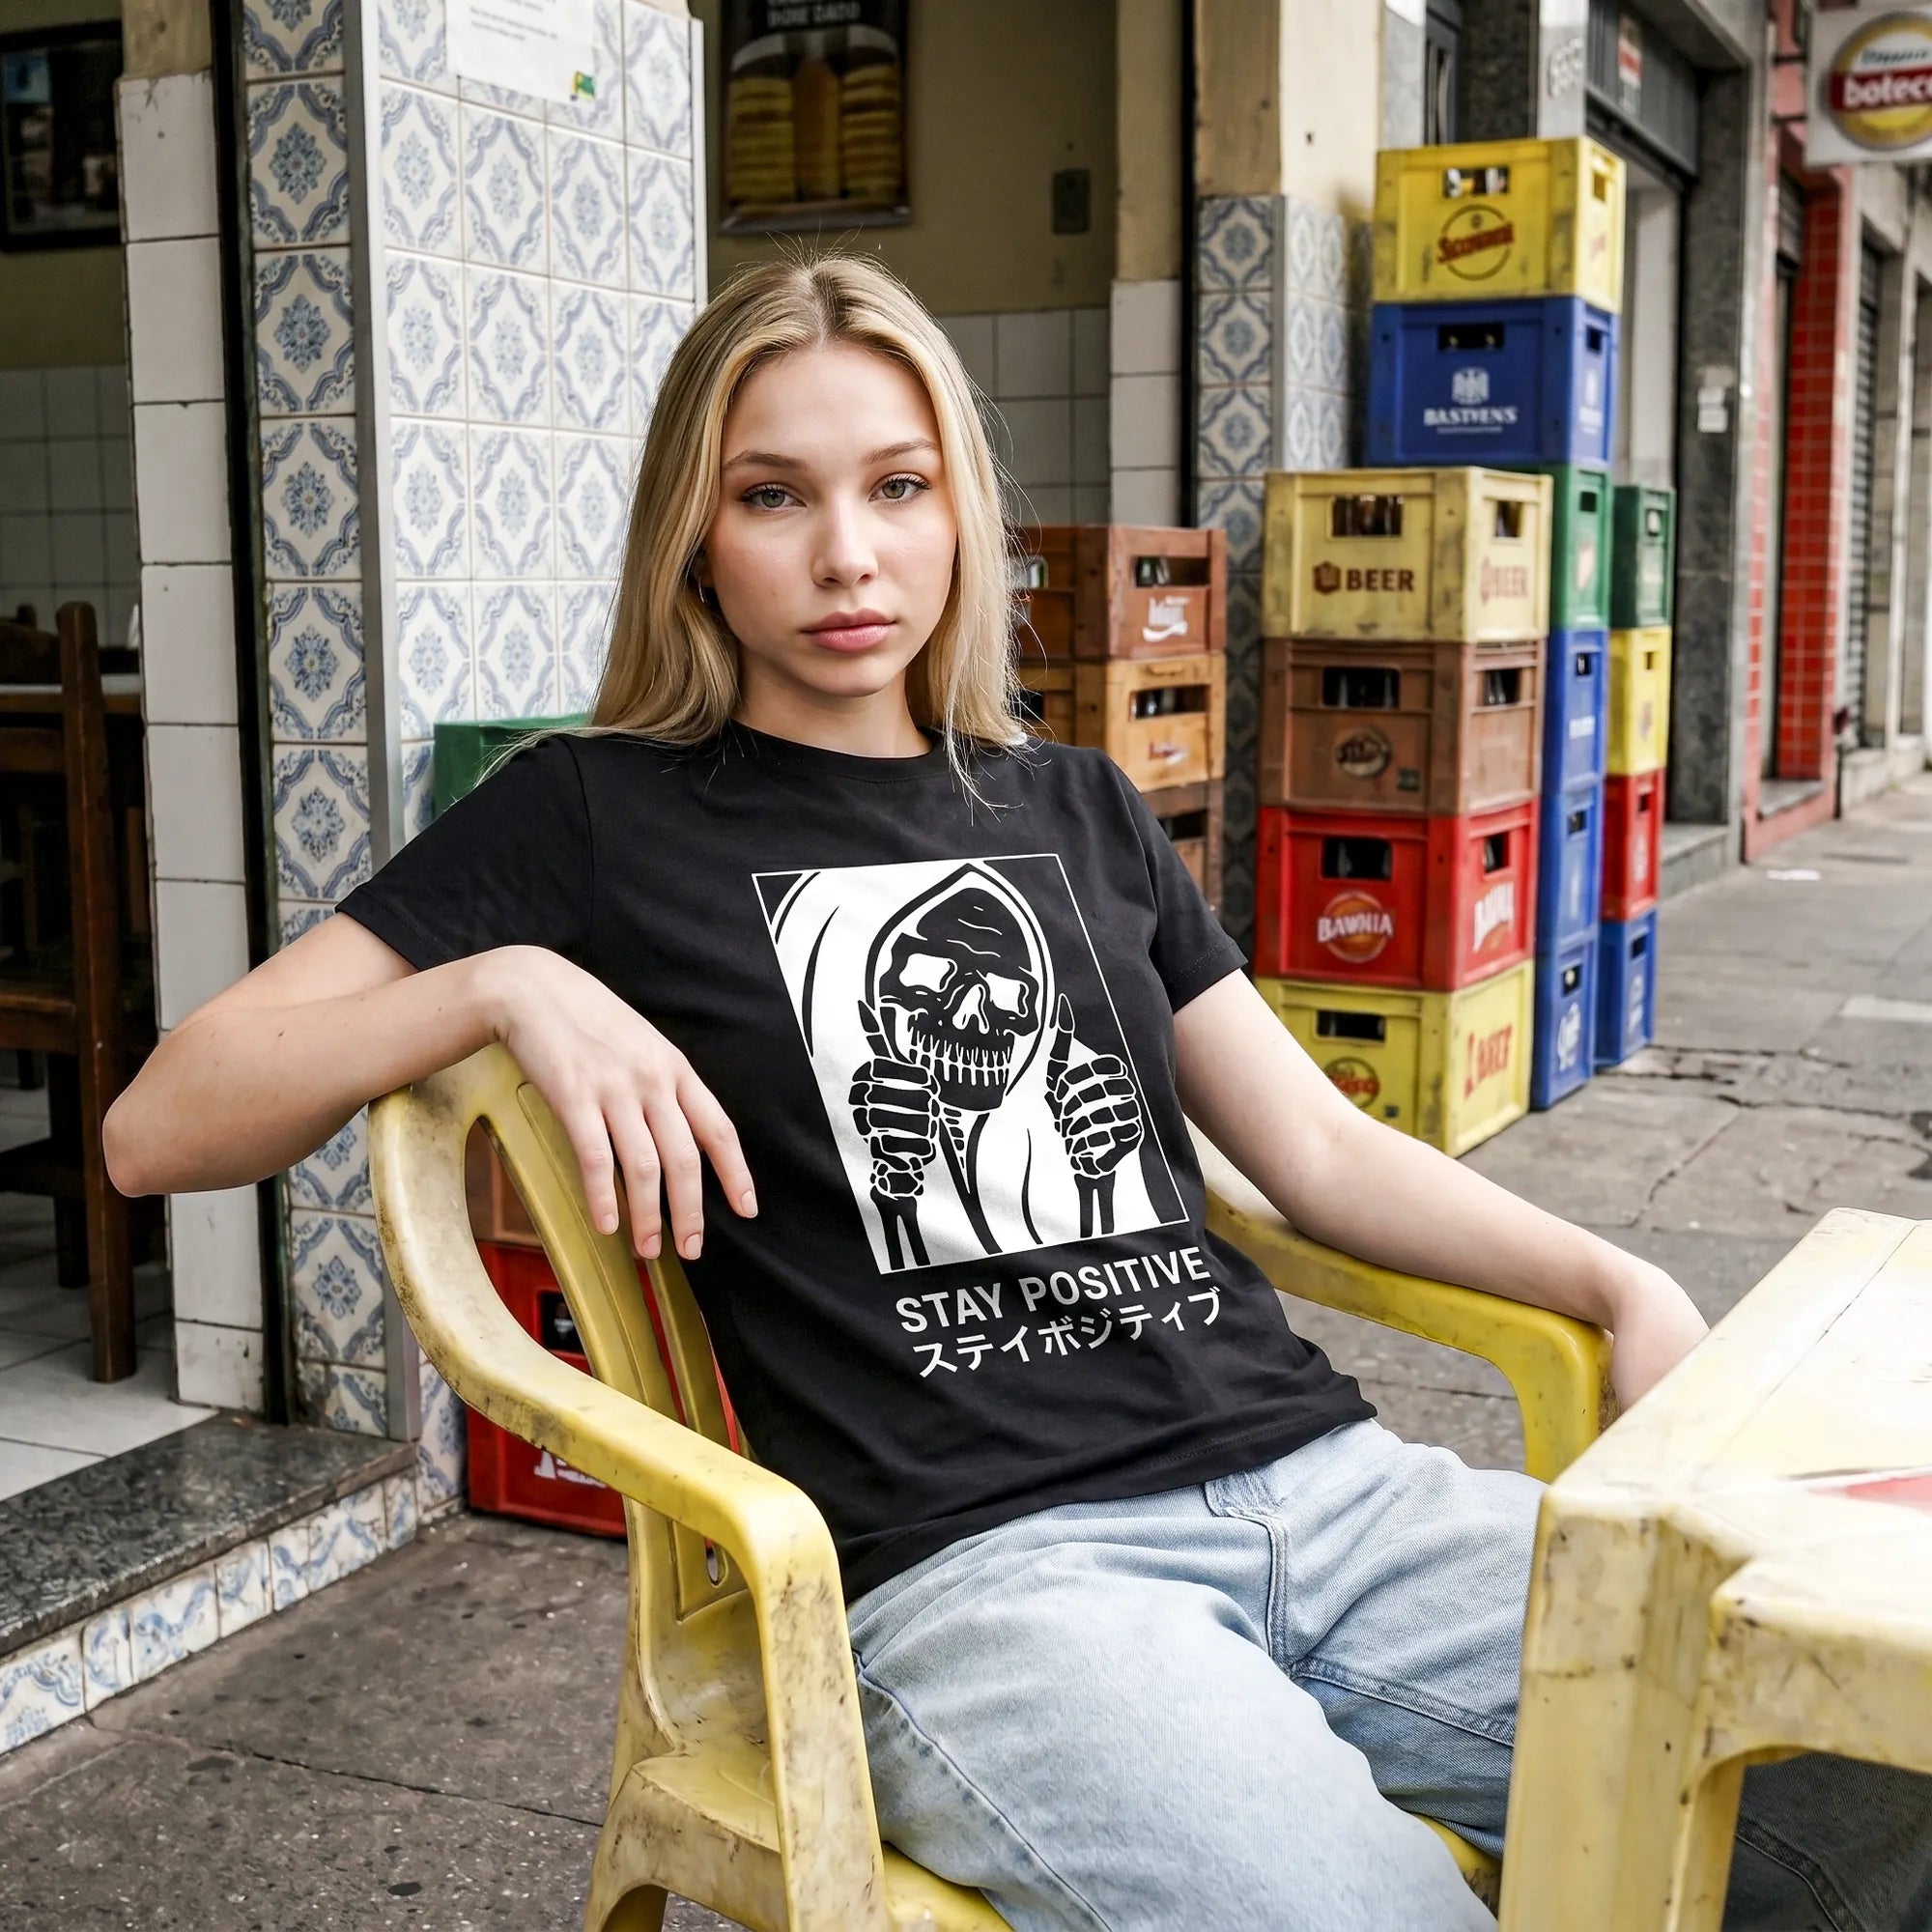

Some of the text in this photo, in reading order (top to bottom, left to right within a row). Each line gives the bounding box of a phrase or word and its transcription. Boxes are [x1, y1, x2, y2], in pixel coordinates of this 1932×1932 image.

[1843, 72, 1932, 109] botec
[1346, 568, 1415, 592] BEER
[895, 1246, 1211, 1333] STAY POSITIVE
[913, 1286, 1221, 1378] ステイボジティブ
